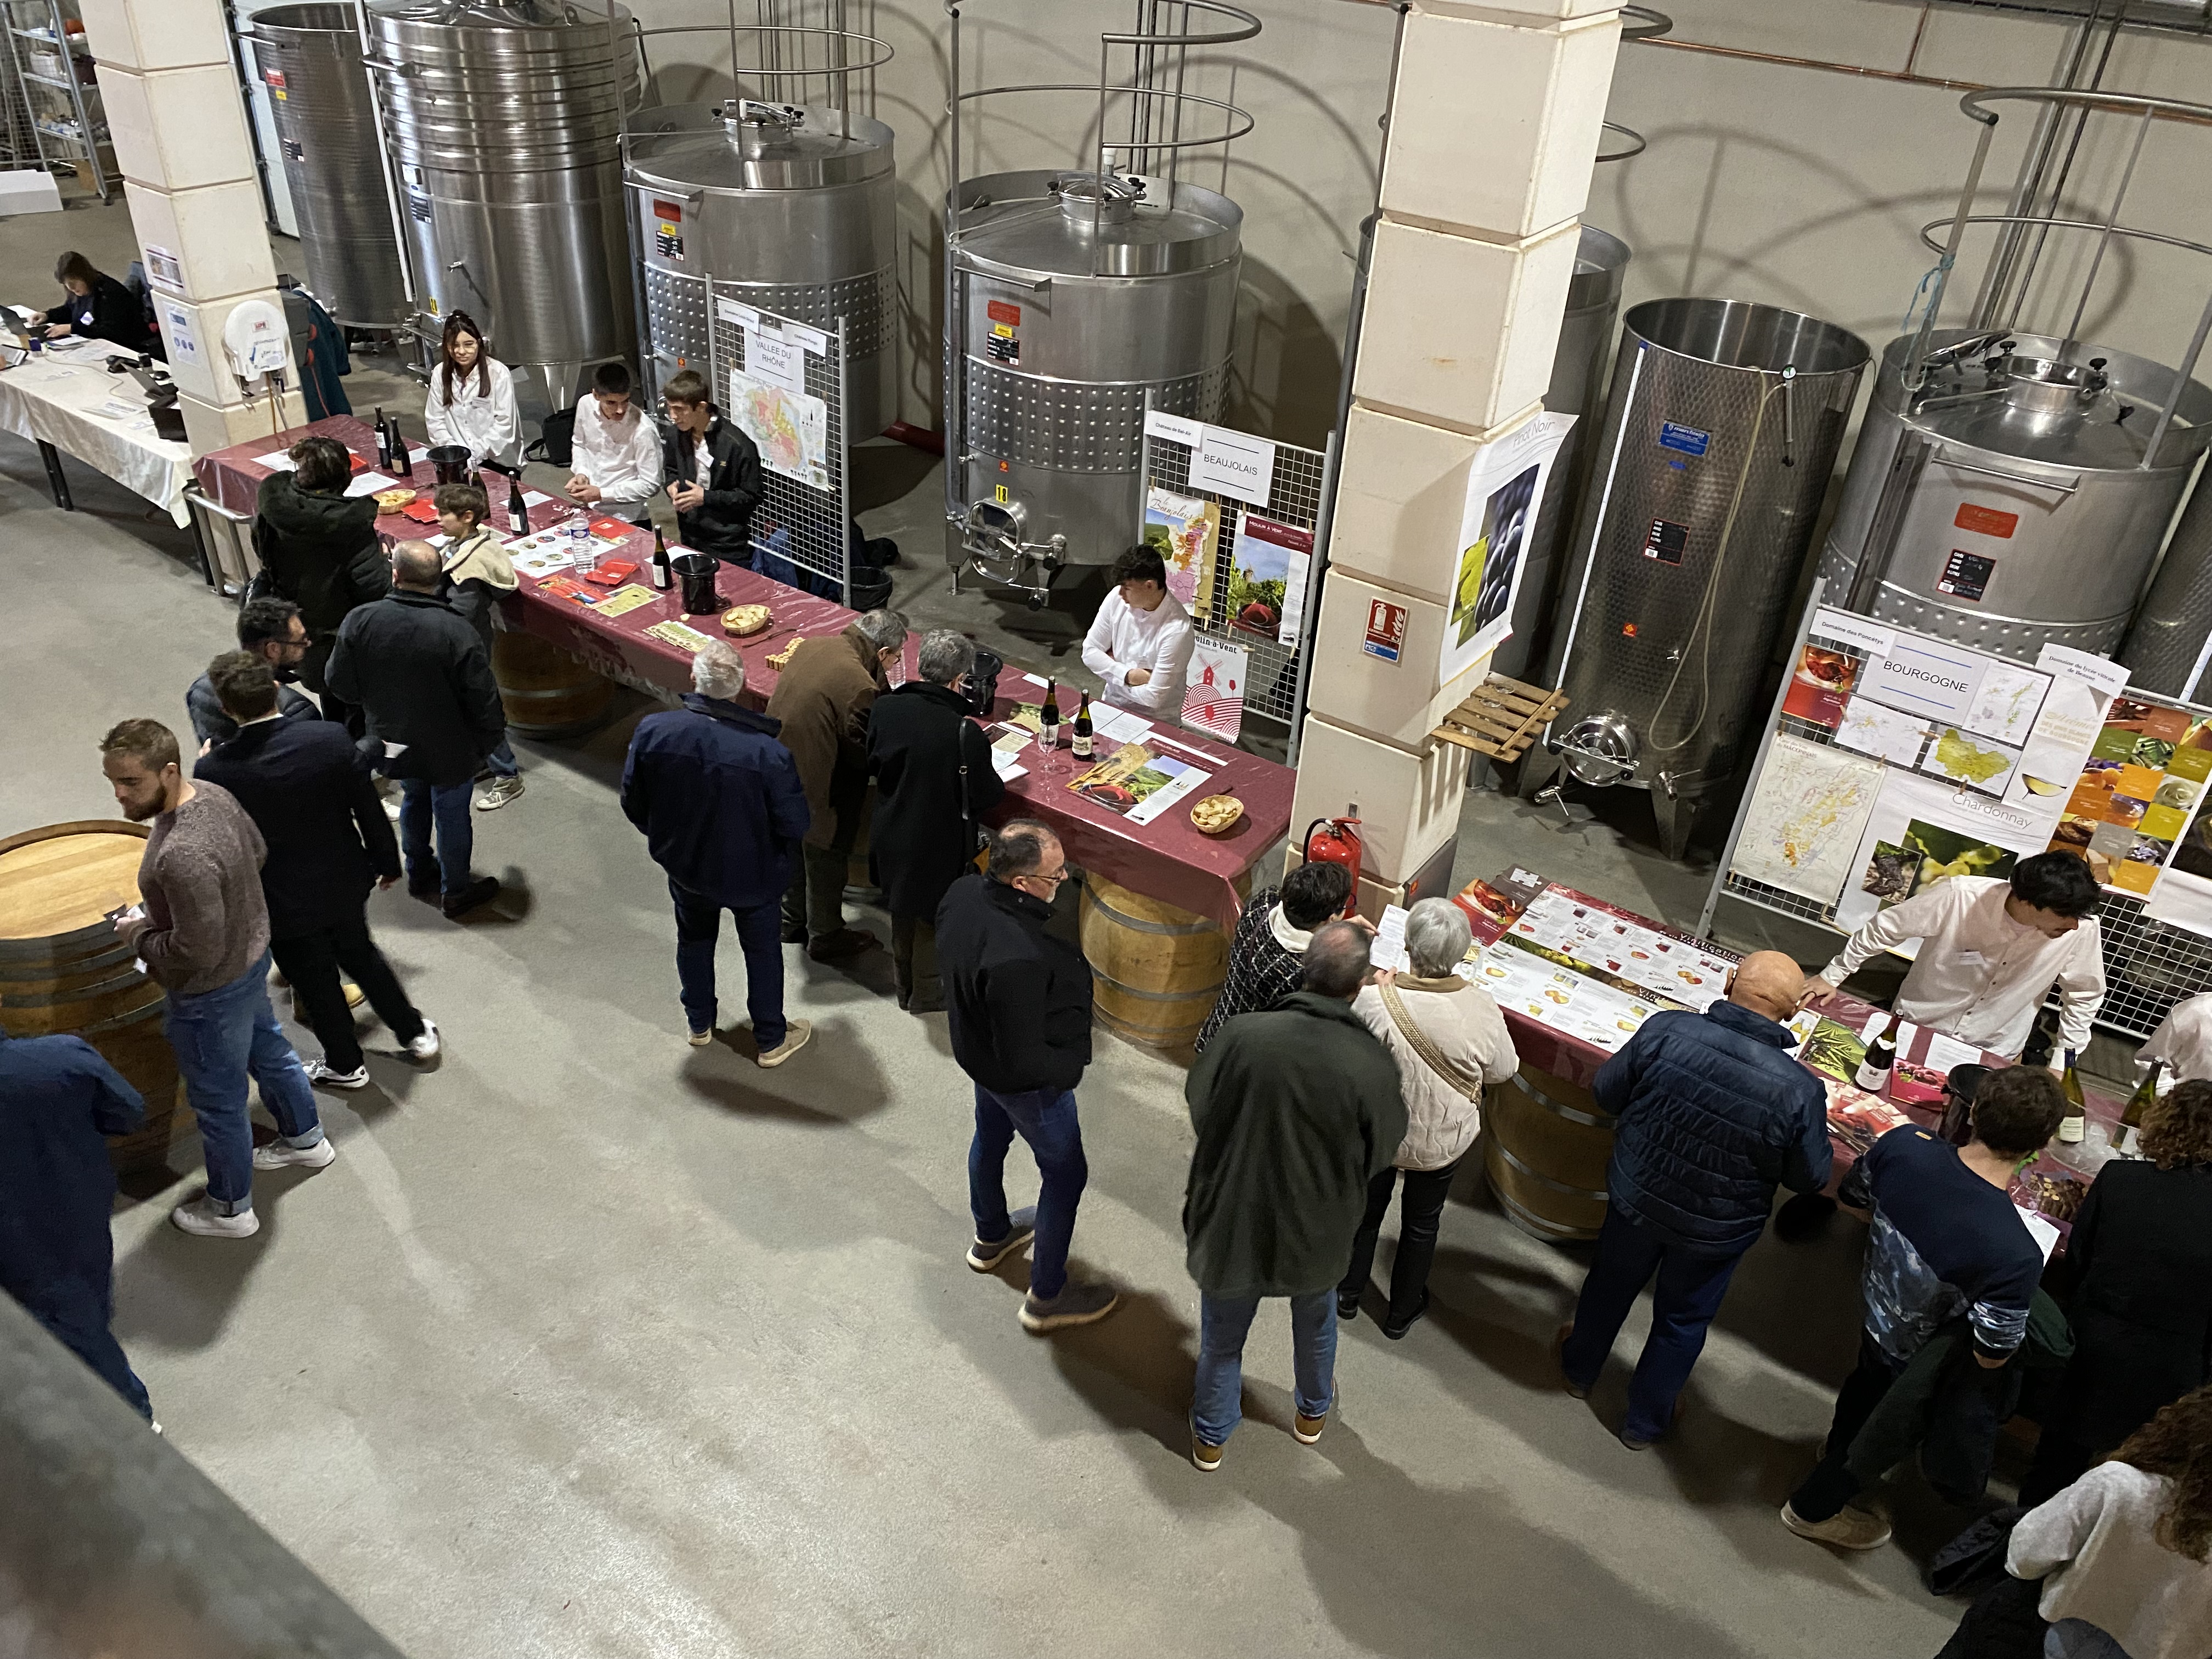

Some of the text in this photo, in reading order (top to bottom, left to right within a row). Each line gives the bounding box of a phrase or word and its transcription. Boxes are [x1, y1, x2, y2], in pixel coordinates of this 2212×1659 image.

[755, 340, 791, 359] VALLEE DU
[762, 354, 785, 369] RHÔNE
[1155, 422, 1171, 431] Château
[1532, 418, 1555, 436] Noir
[1204, 454, 1258, 476] BEAUJOLAIS
[997, 487, 1006, 501] 18
[1822, 622, 1846, 633] Domaine
[1858, 633, 1883, 645] Poncétys
[2049, 656, 2074, 667] Domaine
[1883, 661, 1969, 692] BOURGOGNE
[2075, 670, 2096, 681] Beaune
[1952, 793, 2033, 830] Chardonnay
[1680, 933, 1745, 962] Vinification
